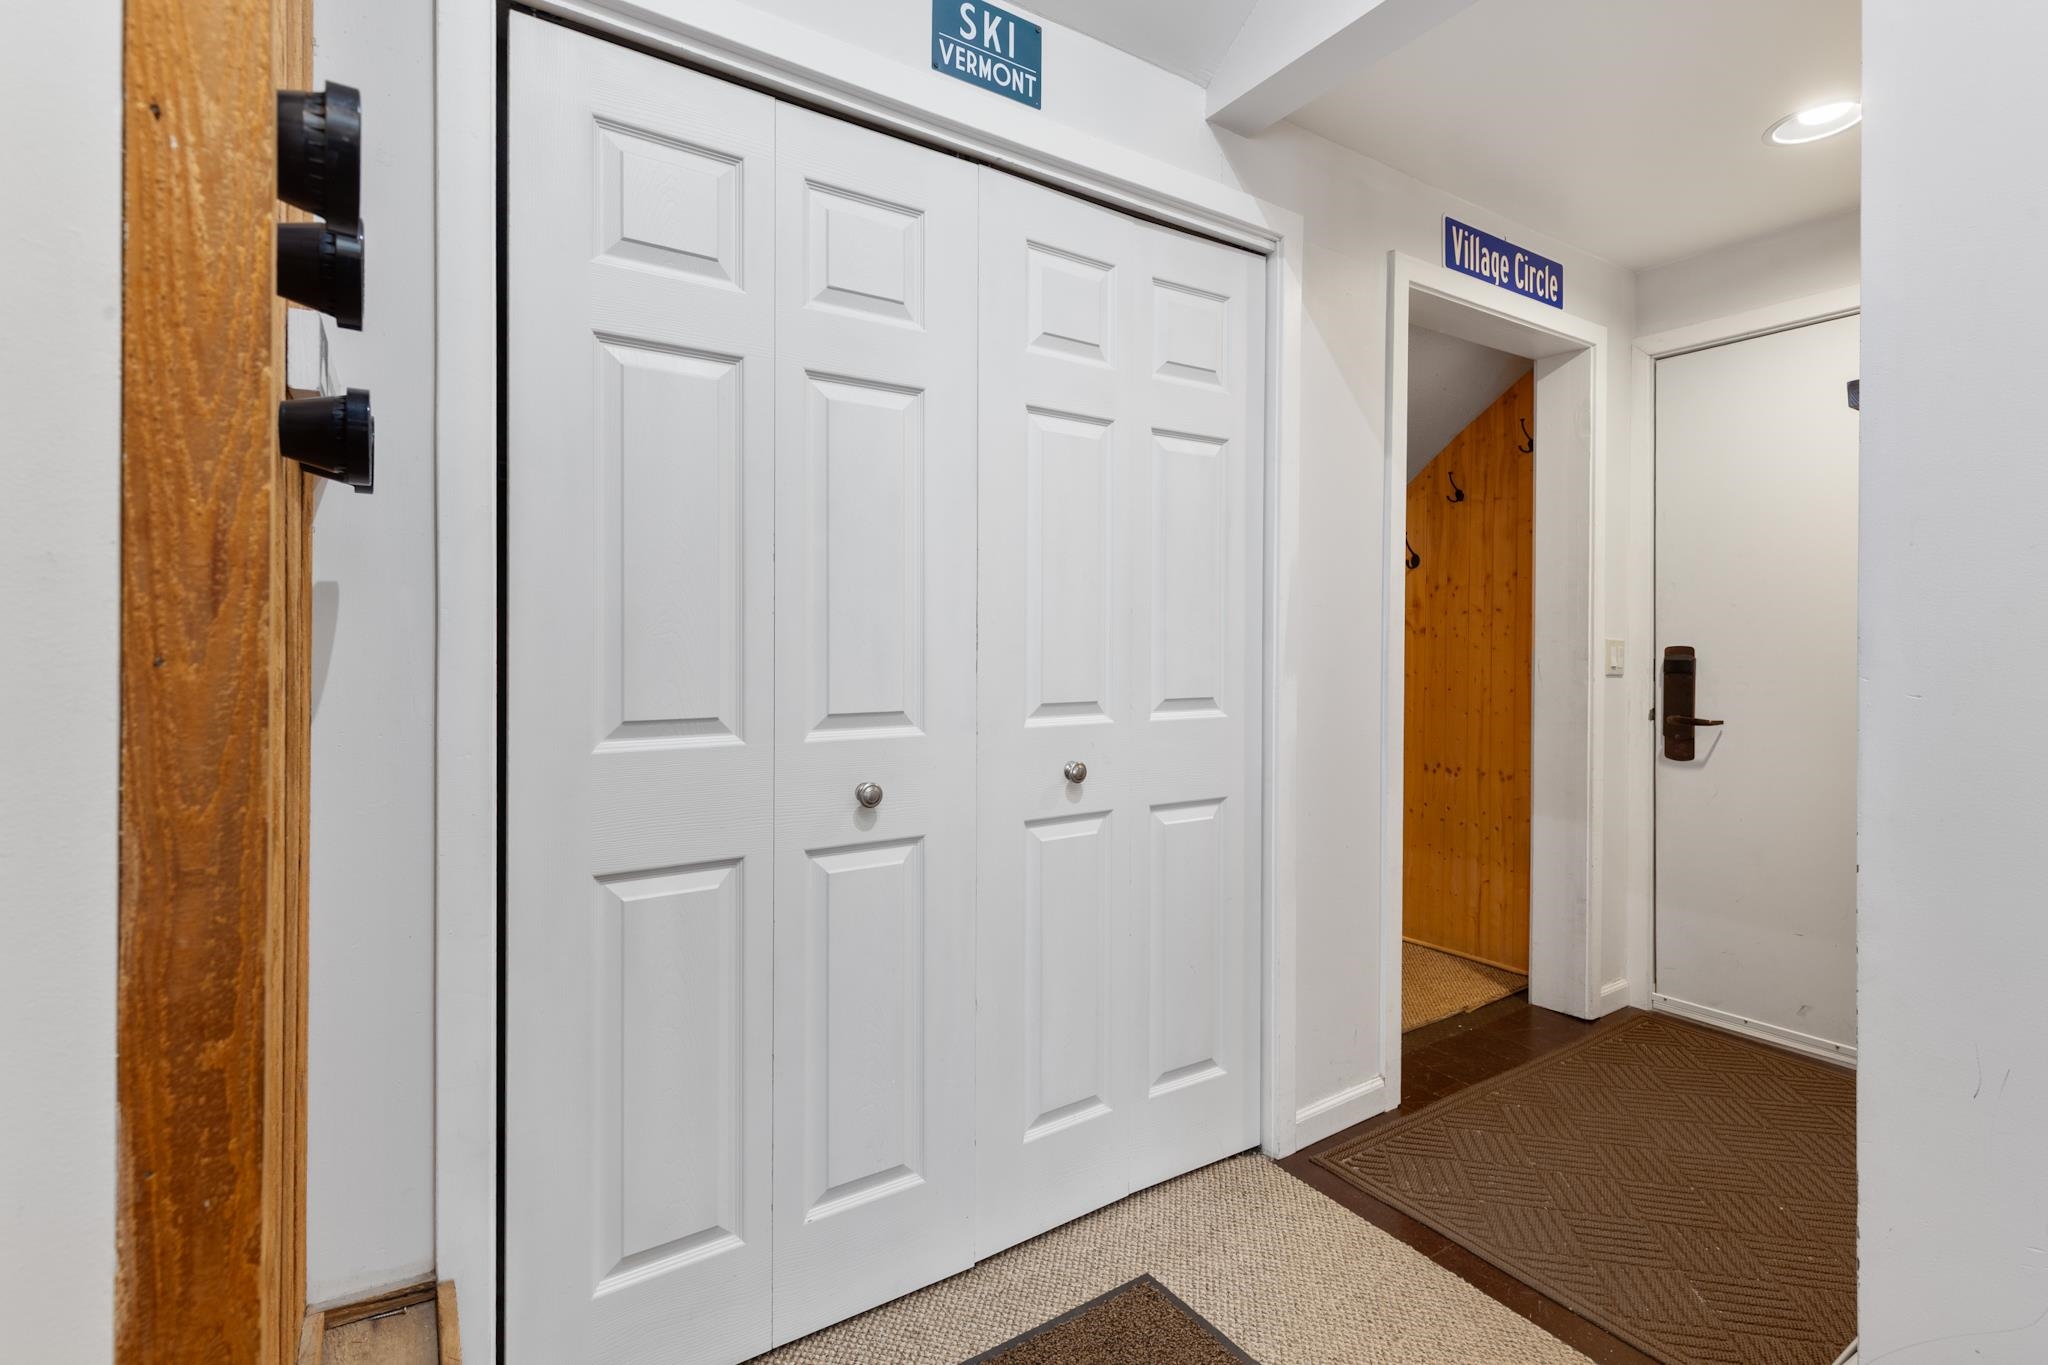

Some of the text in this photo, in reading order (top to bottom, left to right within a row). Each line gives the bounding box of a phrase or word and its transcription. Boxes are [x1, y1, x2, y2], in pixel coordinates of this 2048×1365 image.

[959, 2, 1015, 59] SKI
[939, 38, 1037, 98] VERMONT
[1452, 225, 1558, 302] Village Circle
